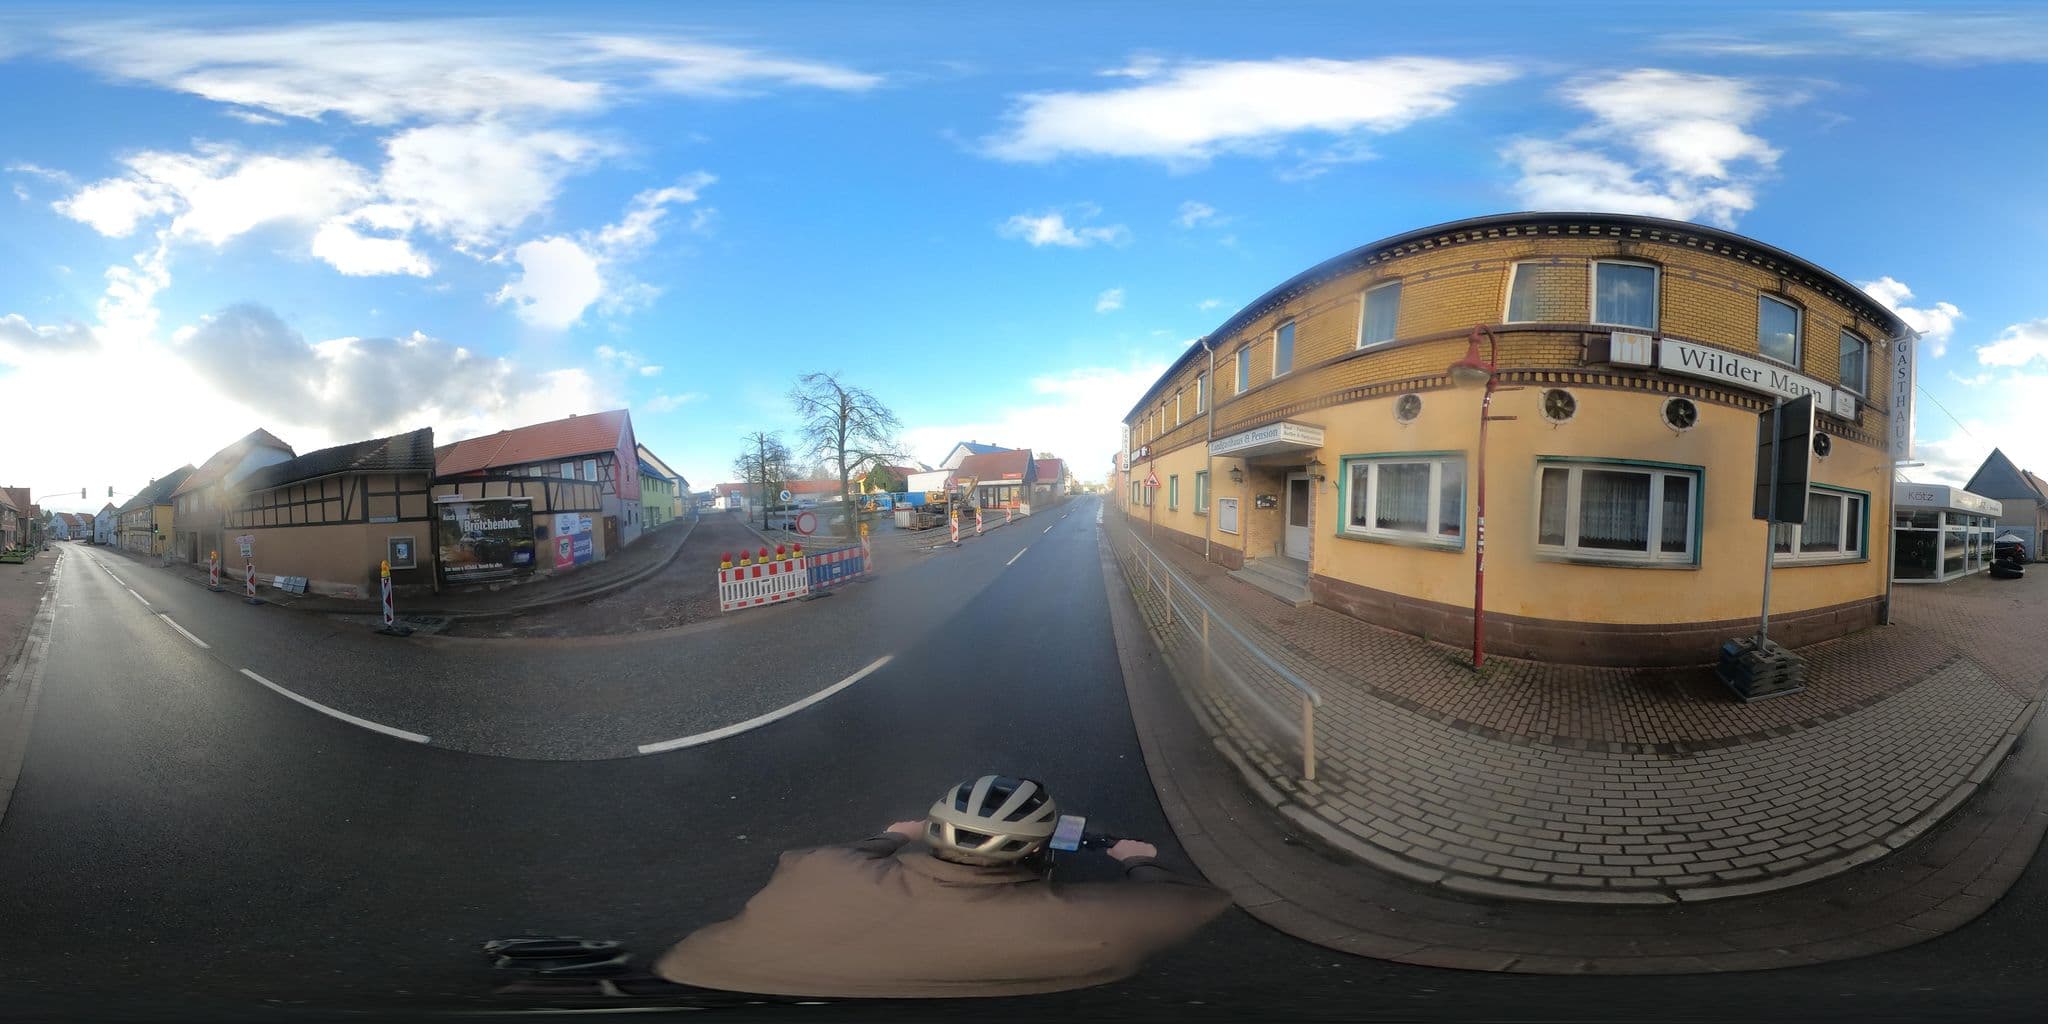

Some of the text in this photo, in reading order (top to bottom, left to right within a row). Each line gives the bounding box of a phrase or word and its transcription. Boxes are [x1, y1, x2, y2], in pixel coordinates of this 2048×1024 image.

[1679, 346, 1822, 404] Wilder Mann
[1895, 341, 1907, 450] GASTHAUS
[1251, 428, 1278, 441] Pension
